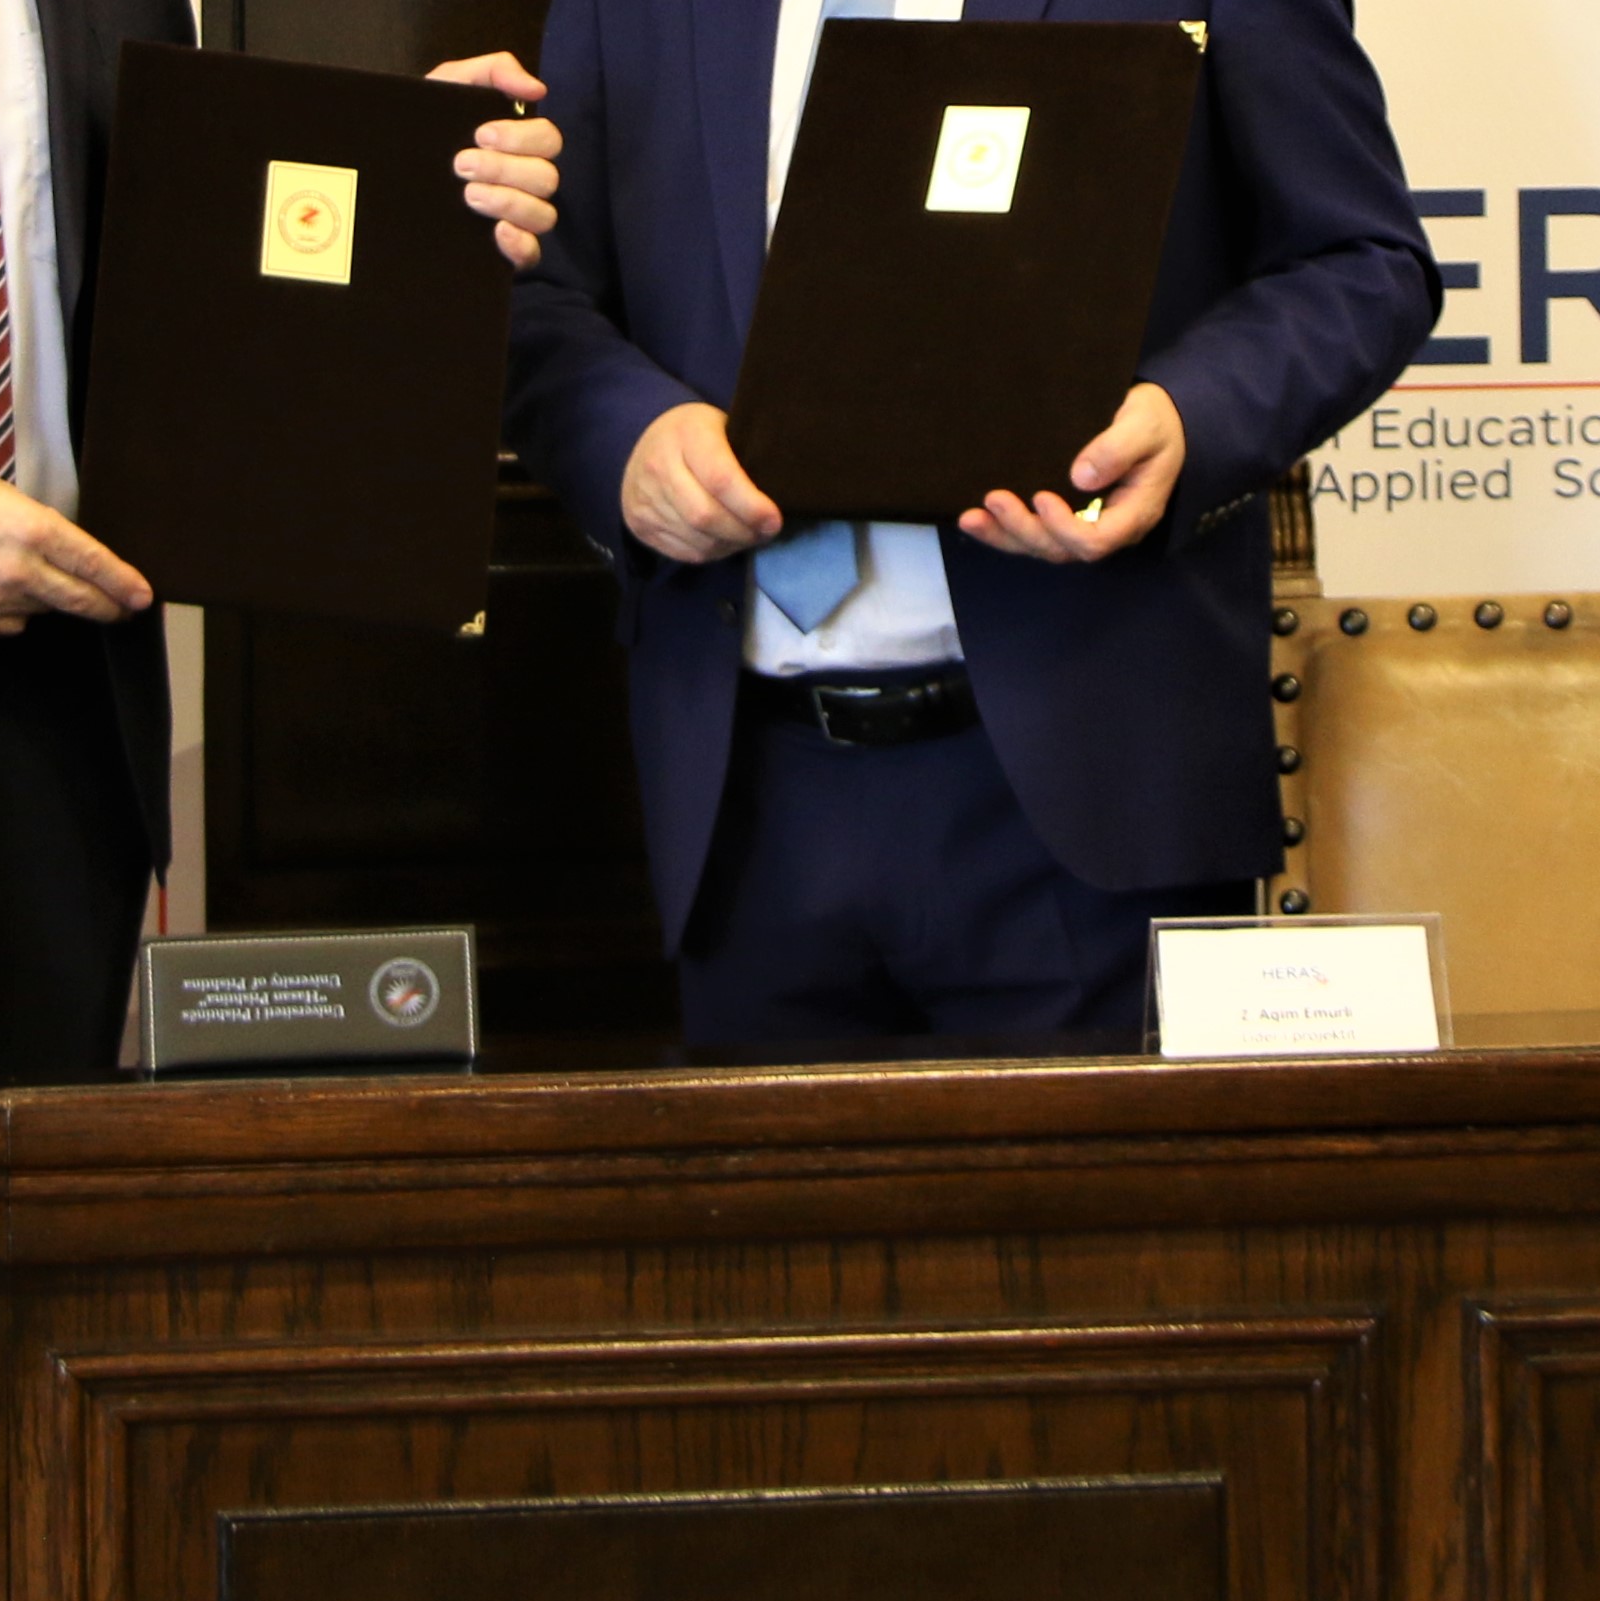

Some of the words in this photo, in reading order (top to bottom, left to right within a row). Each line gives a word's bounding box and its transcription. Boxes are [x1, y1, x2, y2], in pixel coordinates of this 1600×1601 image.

[1314, 458, 1513, 512] Applied
[183, 977, 247, 991] Prishtina
[270, 972, 342, 989] University
[265, 1004, 346, 1021] Universiteti
